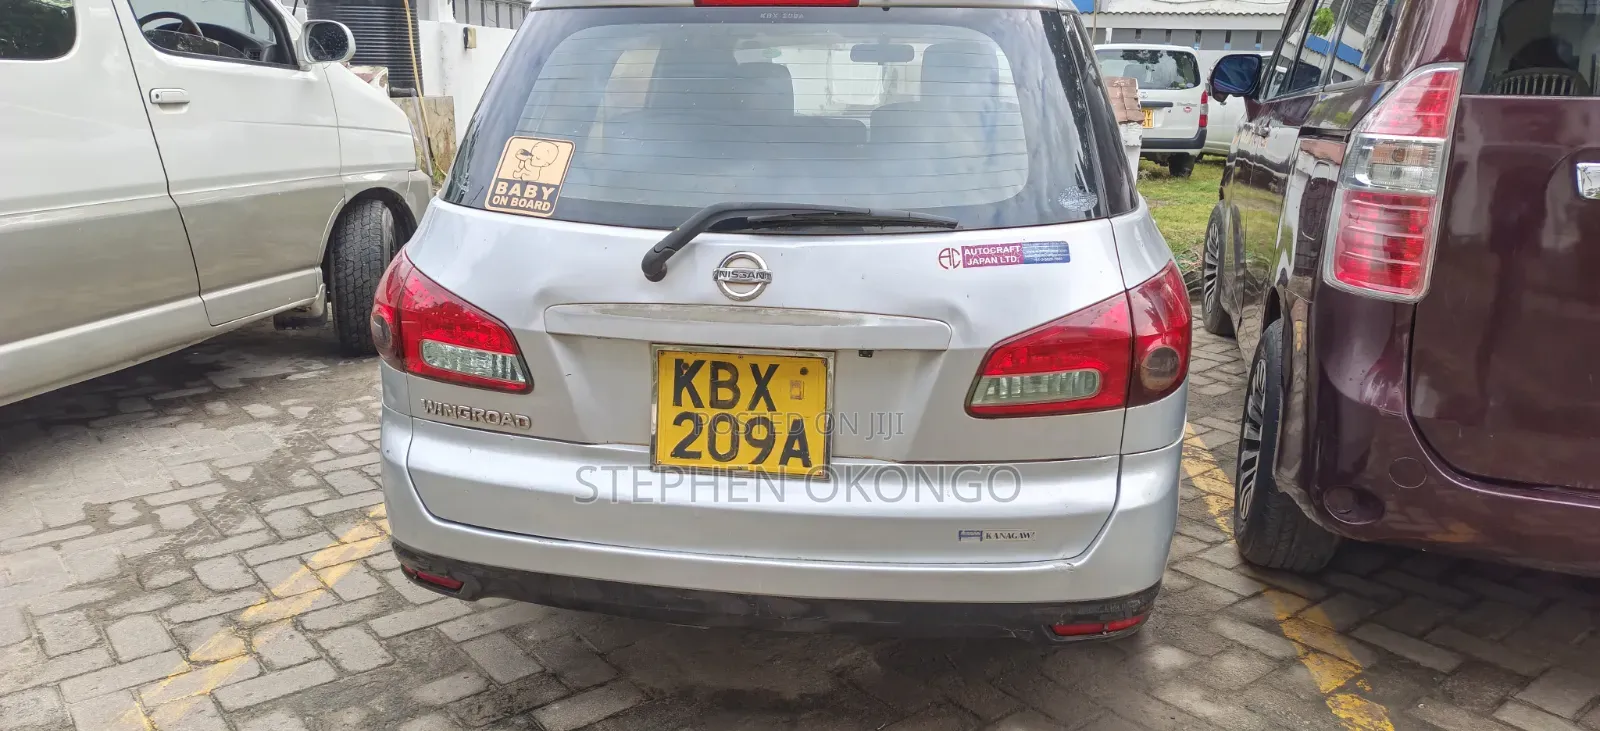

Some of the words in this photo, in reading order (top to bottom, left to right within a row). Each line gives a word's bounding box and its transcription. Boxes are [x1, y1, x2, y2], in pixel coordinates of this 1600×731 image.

[495, 181, 555, 200] BABY
[492, 195, 509, 206] ON
[510, 197, 551, 211] BOARD
[964, 245, 1021, 256] AUTOCRAFT
[967, 257, 998, 266] JAPAN
[719, 270, 764, 280] NISSAN
[672, 358, 781, 412] KBX
[420, 398, 532, 430] WINGROAD
[670, 411, 813, 468] 209A
